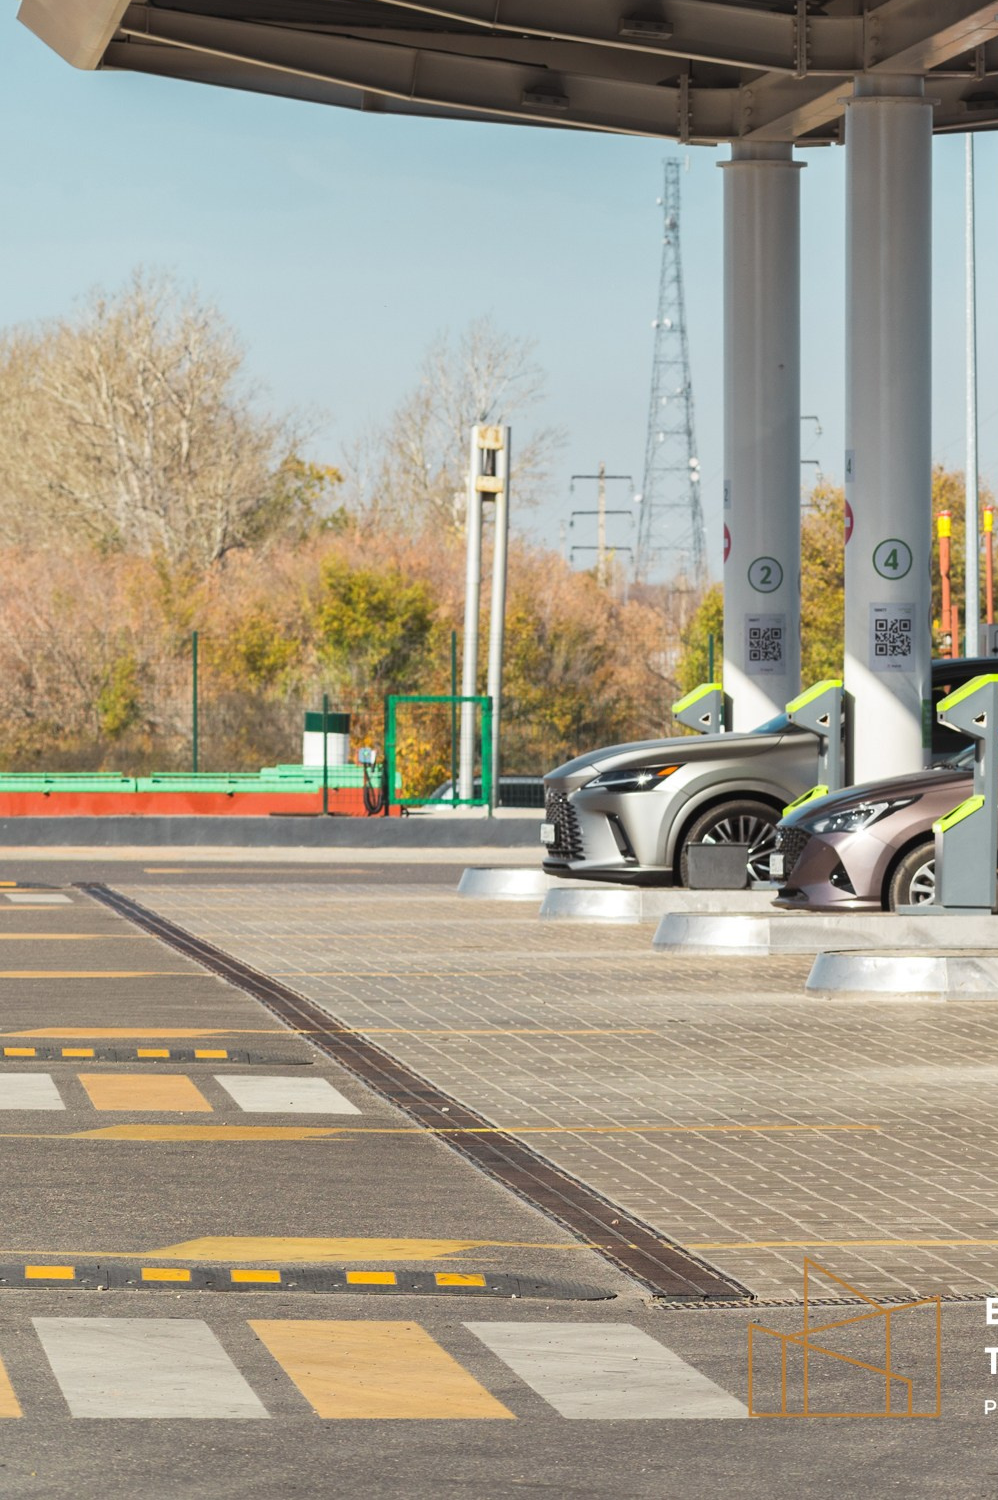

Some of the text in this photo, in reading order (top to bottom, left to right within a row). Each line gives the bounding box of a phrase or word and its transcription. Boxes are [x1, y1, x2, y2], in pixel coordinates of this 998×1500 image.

[846, 458, 851, 474] 4
[884, 548, 899, 570] 4
[760, 565, 772, 585] 2
